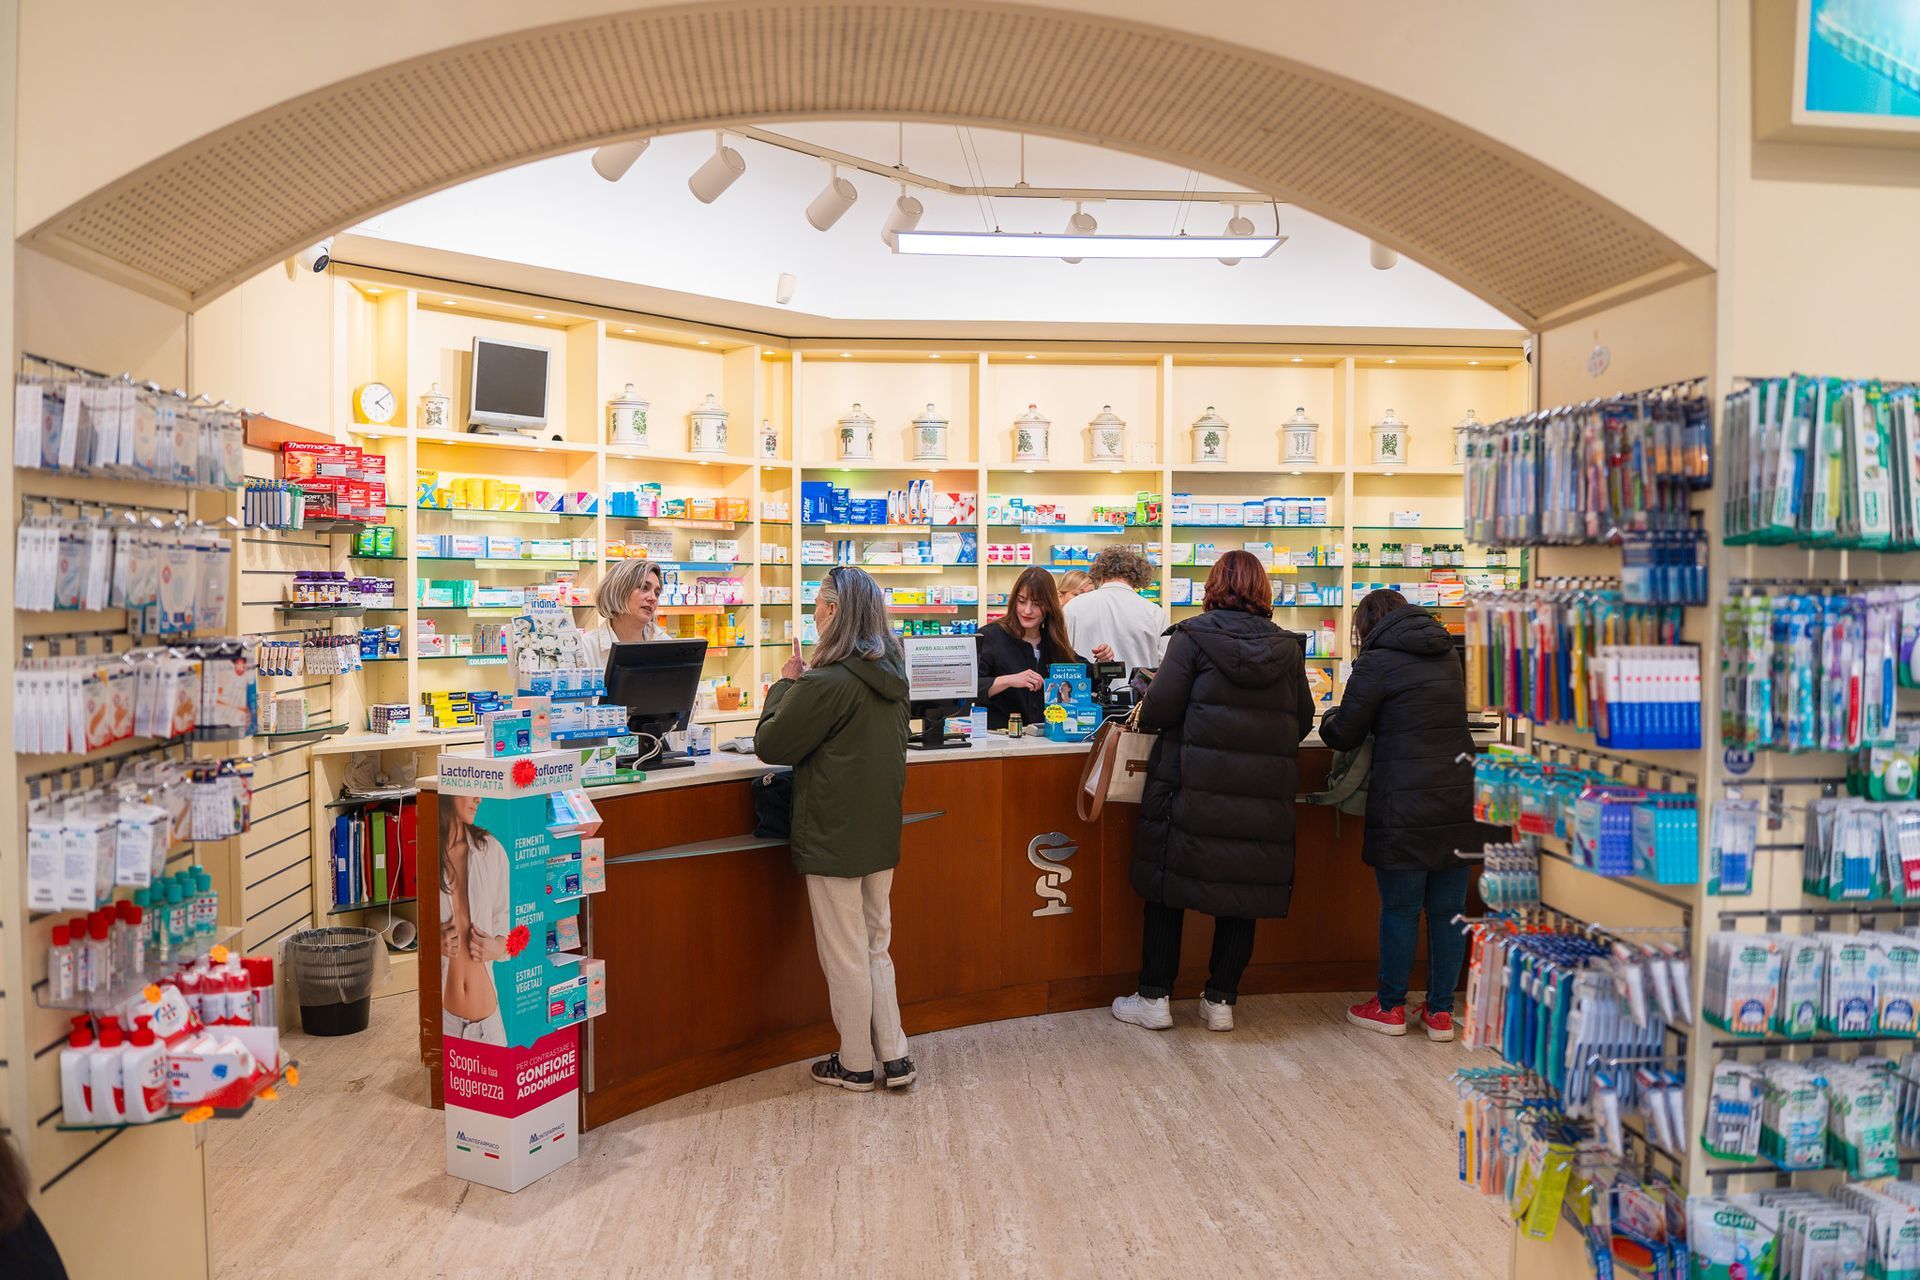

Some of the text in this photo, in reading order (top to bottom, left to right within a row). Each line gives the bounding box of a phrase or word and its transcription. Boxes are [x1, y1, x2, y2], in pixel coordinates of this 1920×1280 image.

[287, 441, 343, 451] ThermaCare
[531, 599, 557, 609] iridina
[469, 657, 508, 665] COLESTEROLO
[441, 765, 504, 781] Lactoflorene
[441, 777, 472, 789] PANCIA
[473, 779, 504, 791] PIATTA
[549, 773, 573, 784] PIATTA
[515, 834, 545, 849] FERMENTI
[515, 845, 550, 861] LATTICI VIVI
[515, 902, 536, 916] ENZIMI
[515, 912, 544, 927] DIGESTIVI
[515, 965, 543, 981] ESTRATTI
[515, 977, 543, 994] VEGETALI
[450, 1049, 481, 1077] Scopri
[516, 1061, 528, 1071] PER
[529, 1042, 570, 1066] CONTRASTARE
[516, 1050, 576, 1086] GONFIORE
[450, 1071, 504, 1101] leggerezza
[517, 1065, 576, 1100] ADDOMINALE
[456, 1130, 500, 1150] MONTEFARMACO
[1714, 1212, 1758, 1231] GUM
